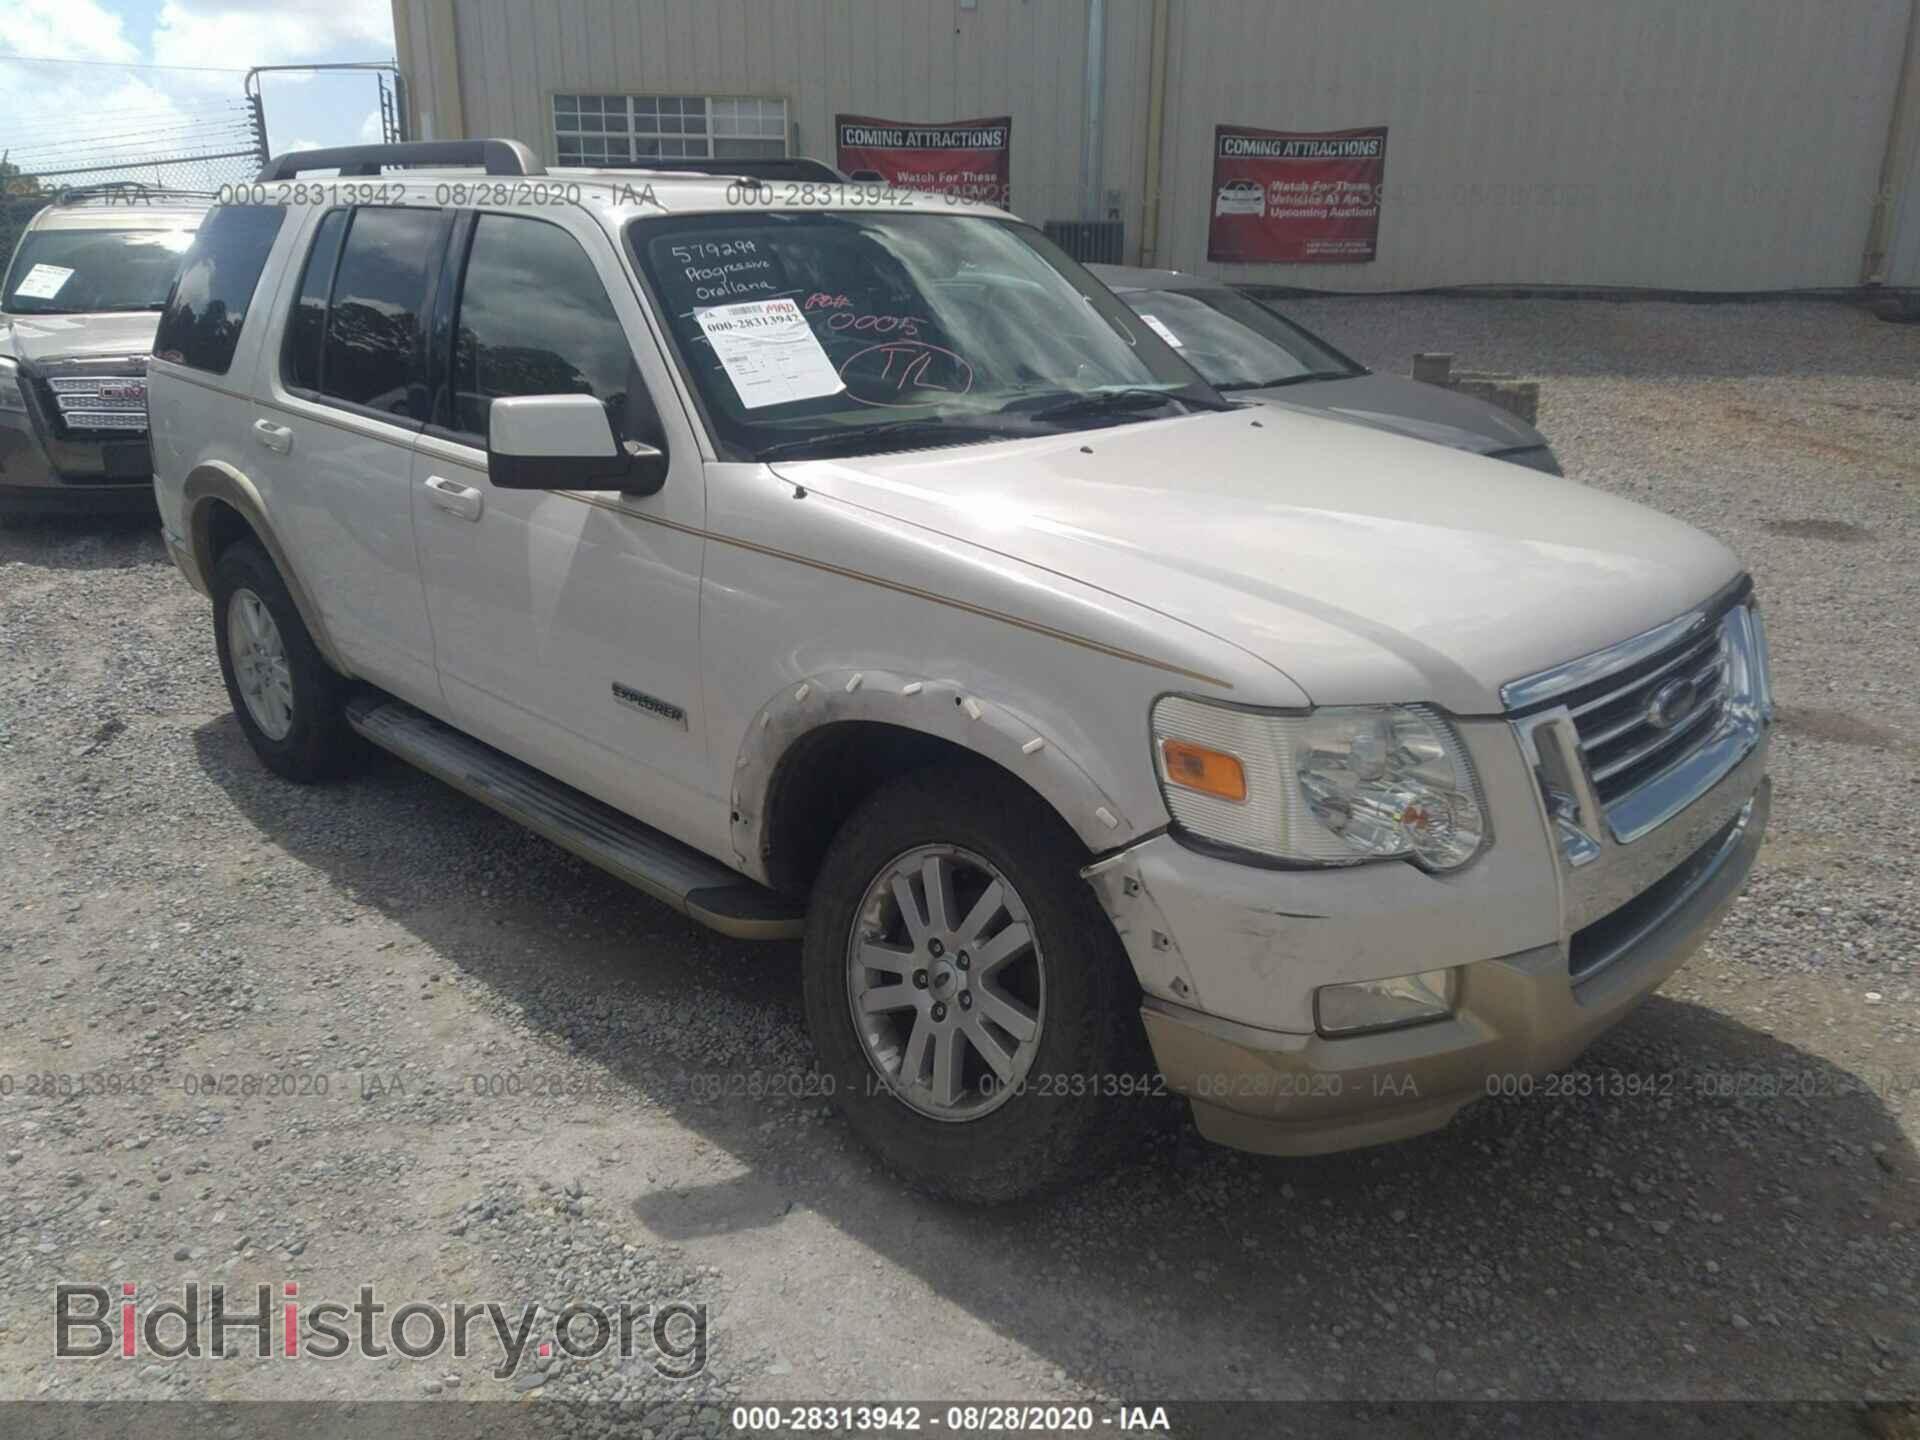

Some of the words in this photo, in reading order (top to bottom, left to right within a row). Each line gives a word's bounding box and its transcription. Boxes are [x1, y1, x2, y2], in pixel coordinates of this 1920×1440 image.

[845, 129, 902, 147] COMING
[906, 129, 1002, 147] ATTRACTIONS
[1224, 139, 1281, 155] COMING
[1283, 140, 1379, 157] ATTRACTIONS
[897, 171, 934, 183] Watch
[939, 171, 958, 183] For
[963, 171, 998, 183] These
[1271, 180, 1309, 192] Watch
[1312, 181, 1335, 192] For
[1336, 181, 1371, 192] These
[1270, 207, 1328, 219] Upcoming
[1329, 207, 1377, 218] Auction!
[706, 313, 801, 334] 000-28313942
